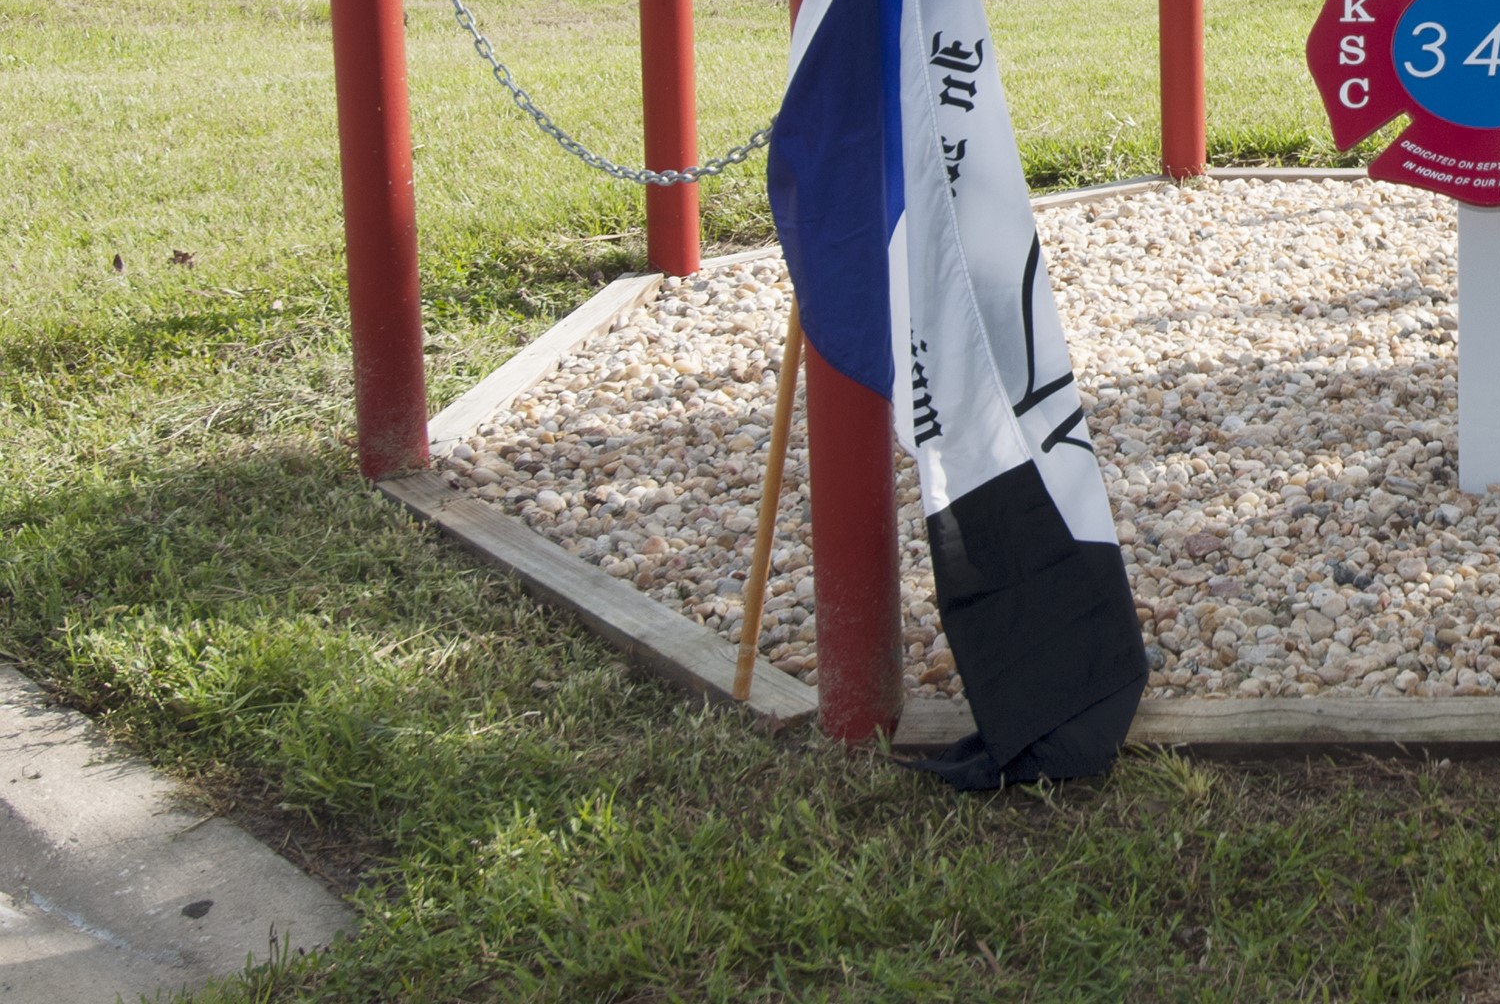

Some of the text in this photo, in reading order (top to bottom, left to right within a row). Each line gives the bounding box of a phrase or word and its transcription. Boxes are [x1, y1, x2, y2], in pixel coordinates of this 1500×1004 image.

[1401, 140, 1456, 167] DEDICATED
[1458, 160, 1474, 170] ON
[1402, 160, 1416, 170] IN
[1415, 165, 1453, 183] HONOR
[1454, 176, 1471, 186] OF
[1473, 178, 1496, 187] OUR
